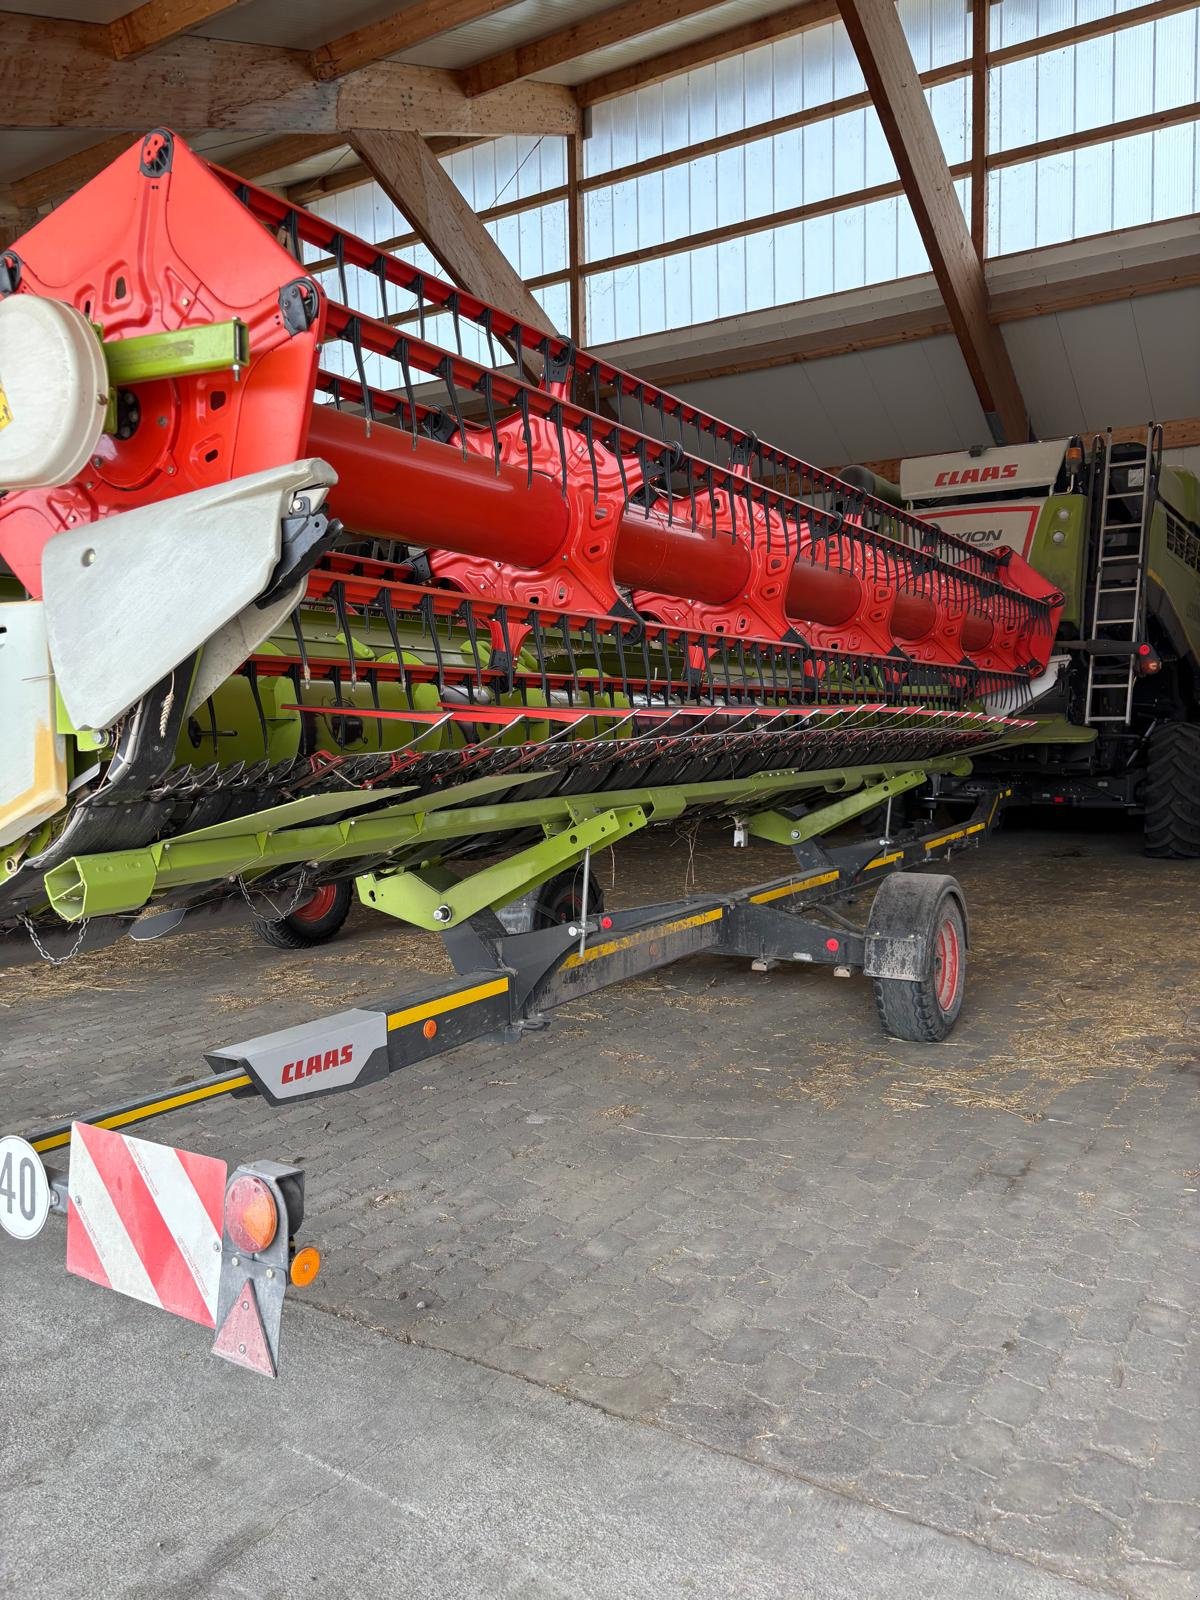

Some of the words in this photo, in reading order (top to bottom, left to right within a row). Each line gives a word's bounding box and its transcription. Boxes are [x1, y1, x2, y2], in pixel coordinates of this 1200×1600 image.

[934, 463, 1019, 487] CLAAS
[951, 529, 1003, 543] XION
[281, 1043, 354, 1085] CLAAS
[0, 1151, 36, 1221] 40
